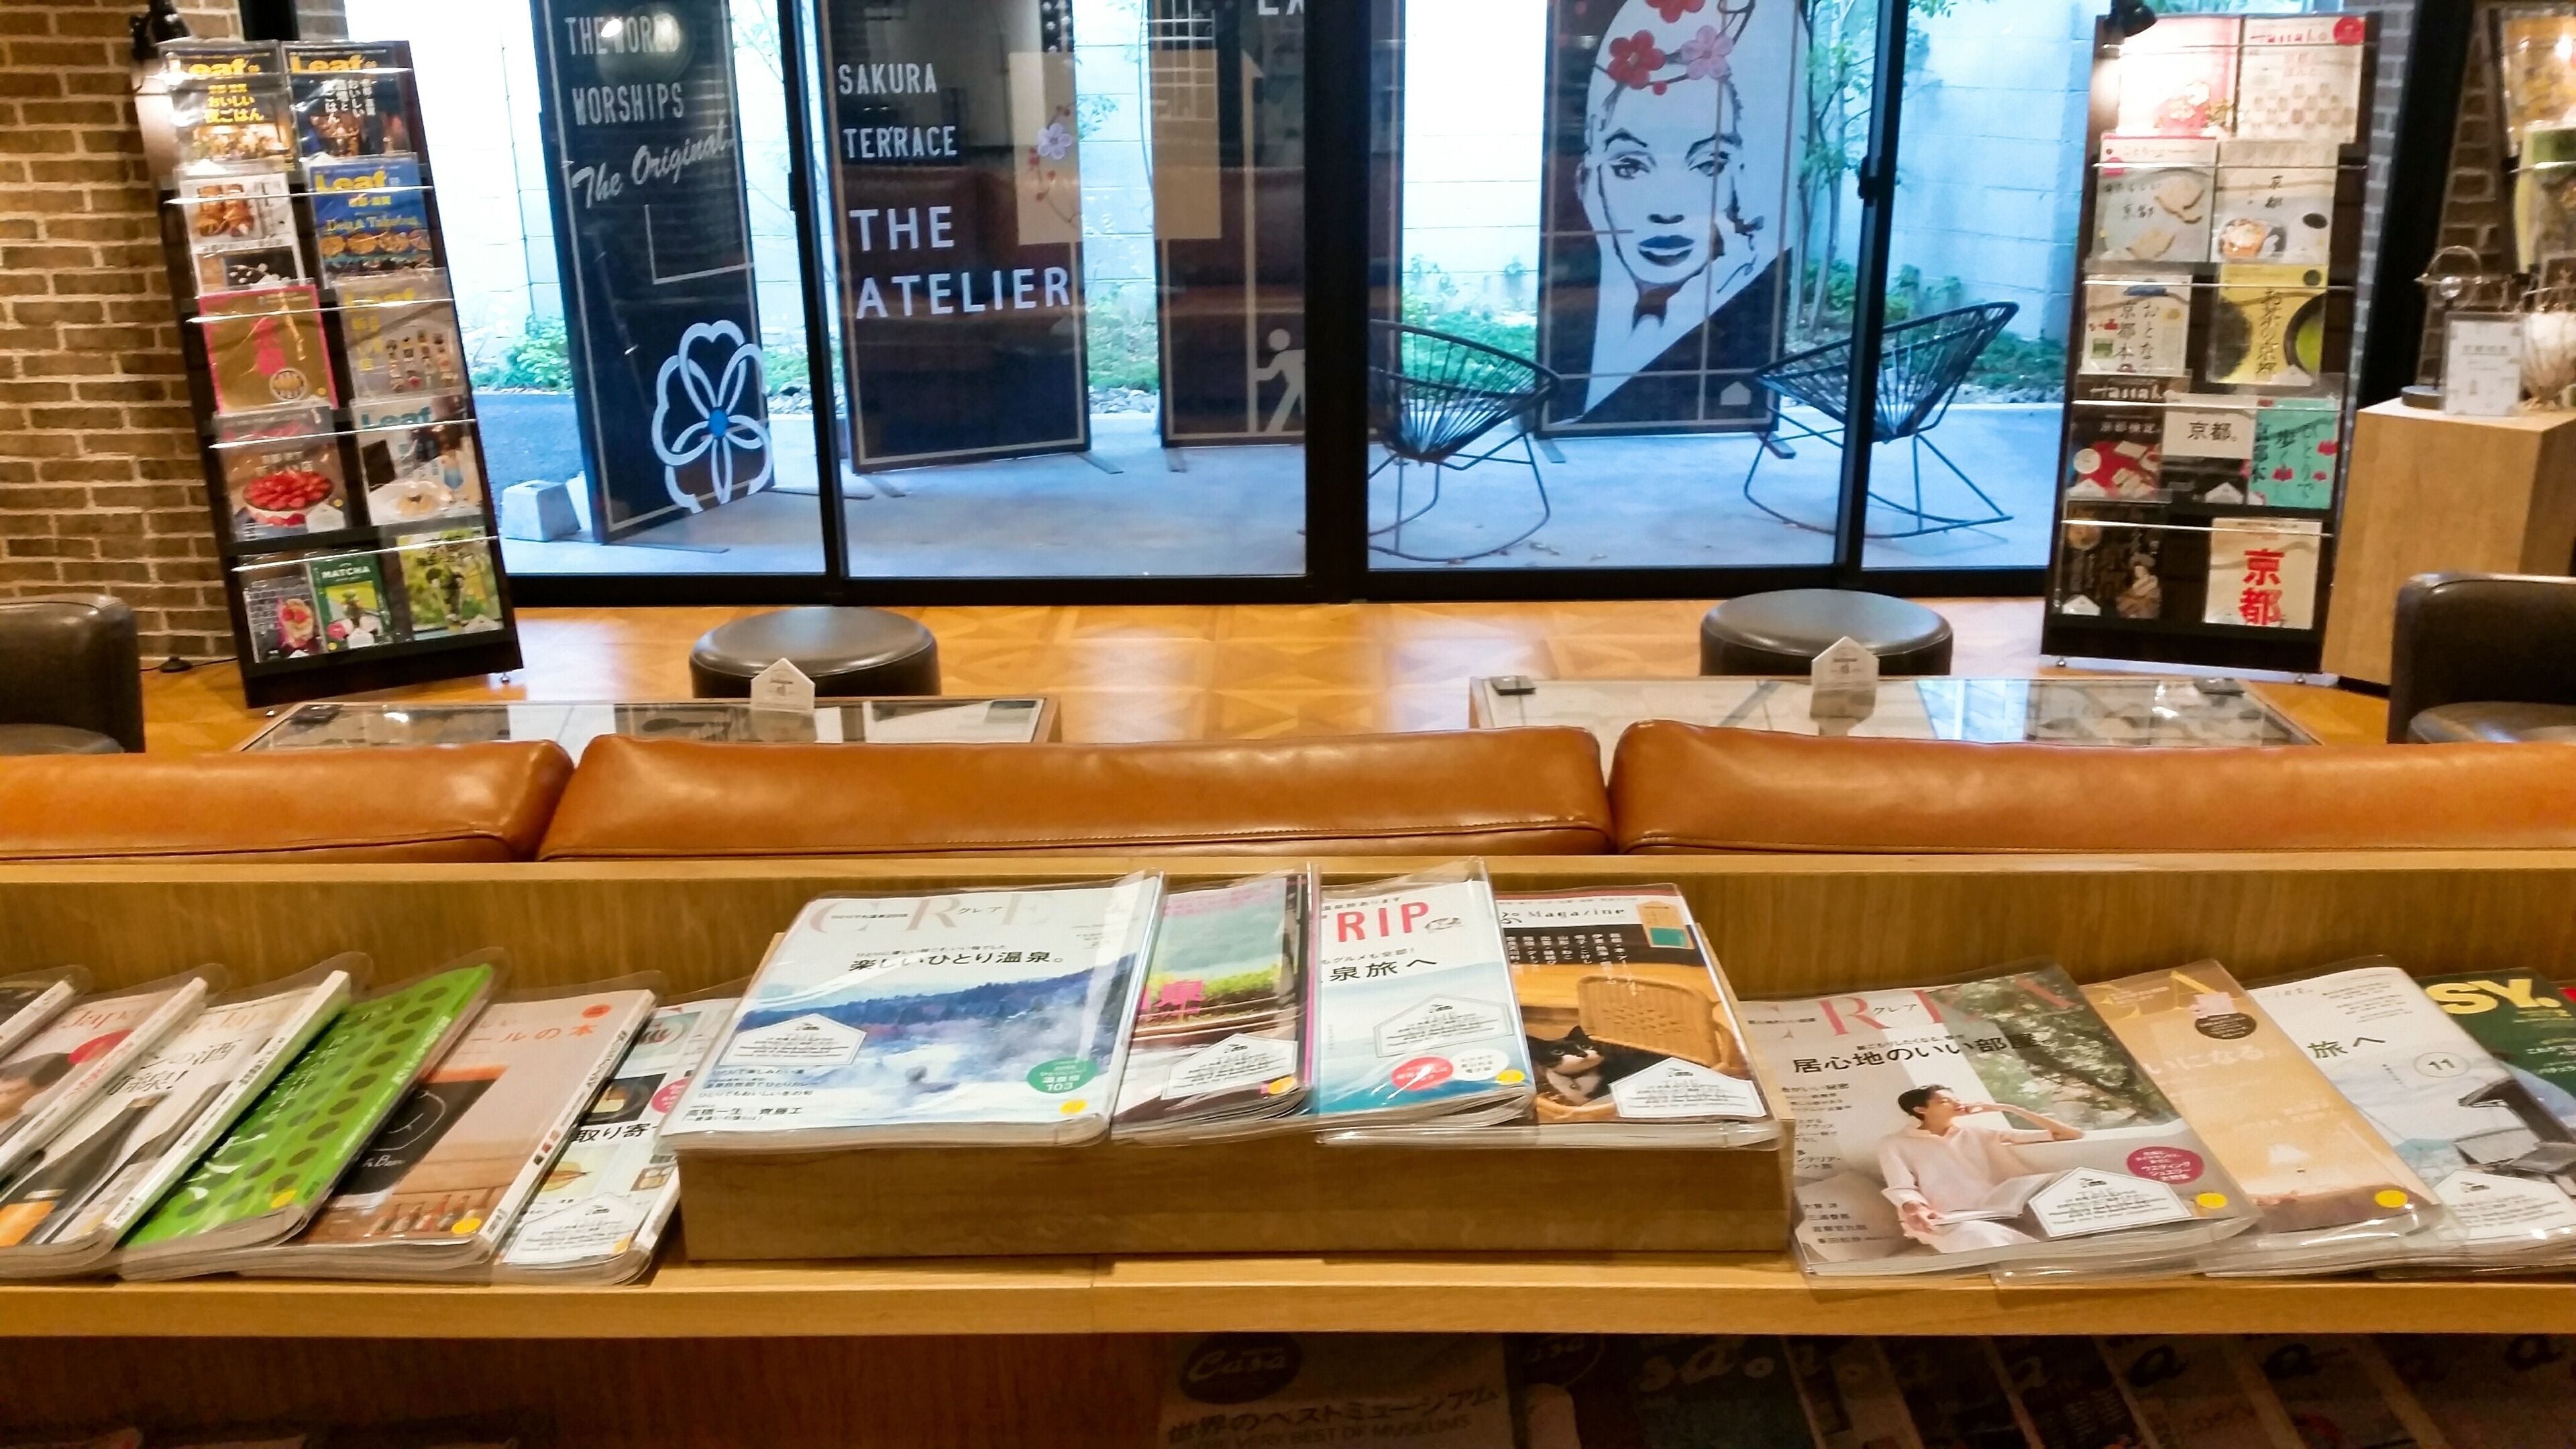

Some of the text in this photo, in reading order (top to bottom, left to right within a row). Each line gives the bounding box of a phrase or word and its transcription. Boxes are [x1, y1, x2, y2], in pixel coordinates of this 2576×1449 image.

[564, 16, 608, 55] THE
[290, 52, 366, 72] Leaf
[838, 62, 937, 95] SAKURA
[572, 83, 684, 125] WORSHIPS
[843, 125, 958, 158] TERRACE
[572, 117, 735, 209] The Original
[314, 170, 386, 193] Leaf
[849, 205, 955, 252] THE
[856, 266, 1070, 319] ATELIER
[2089, 384, 2163, 400] Hanak
[361, 407, 431, 429] Leaf
[2187, 421, 2238, 442] 京都。
[321, 566, 370, 578] MATCHA
[2239, 547, 2285, 626] 京都
[1322, 902, 1429, 943] RIP
[1528, 908, 1625, 918] Magazine
[848, 951, 1064, 971] 楽しいひとり温泉。
[1320, 959, 1438, 982] 泉旅へ
[2307, 1037, 2386, 1059] 旅へ
[2428, 1059, 2455, 1071] 11
[1046, 1081, 1074, 1091] 103
[575, 1124, 659, 1143] 取り寄
[1186, 1346, 1287, 1383] Casa
[1169, 1385, 1499, 1444] 世界のベストミュージアム
[1290, 1428, 1336, 1444] BEST
[1342, 1426, 1364, 1439] OF
